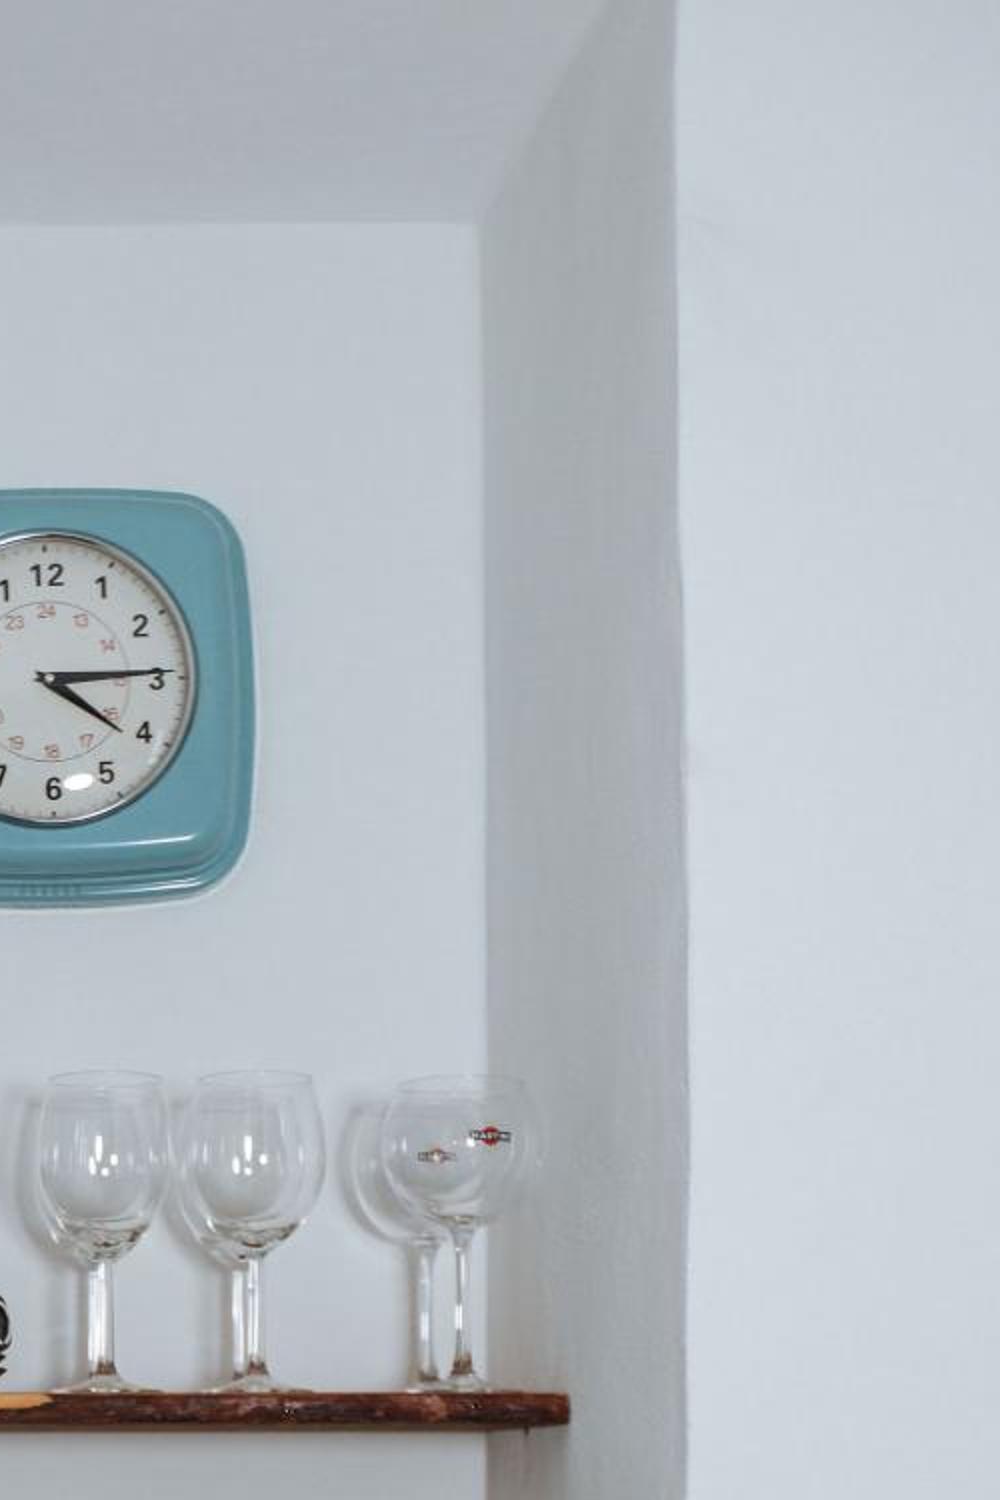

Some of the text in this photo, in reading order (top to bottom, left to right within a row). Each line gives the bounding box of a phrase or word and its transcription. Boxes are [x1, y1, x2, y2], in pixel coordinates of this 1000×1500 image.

[30, 564, 64, 586] 12
[96, 577, 107, 598] 1
[5, 616, 24, 631] 23
[133, 615, 149, 637] 2
[149, 668, 164, 690] 3
[136, 722, 152, 743] 4
[99, 762, 114, 783] 5
[46, 778, 61, 800] 6
